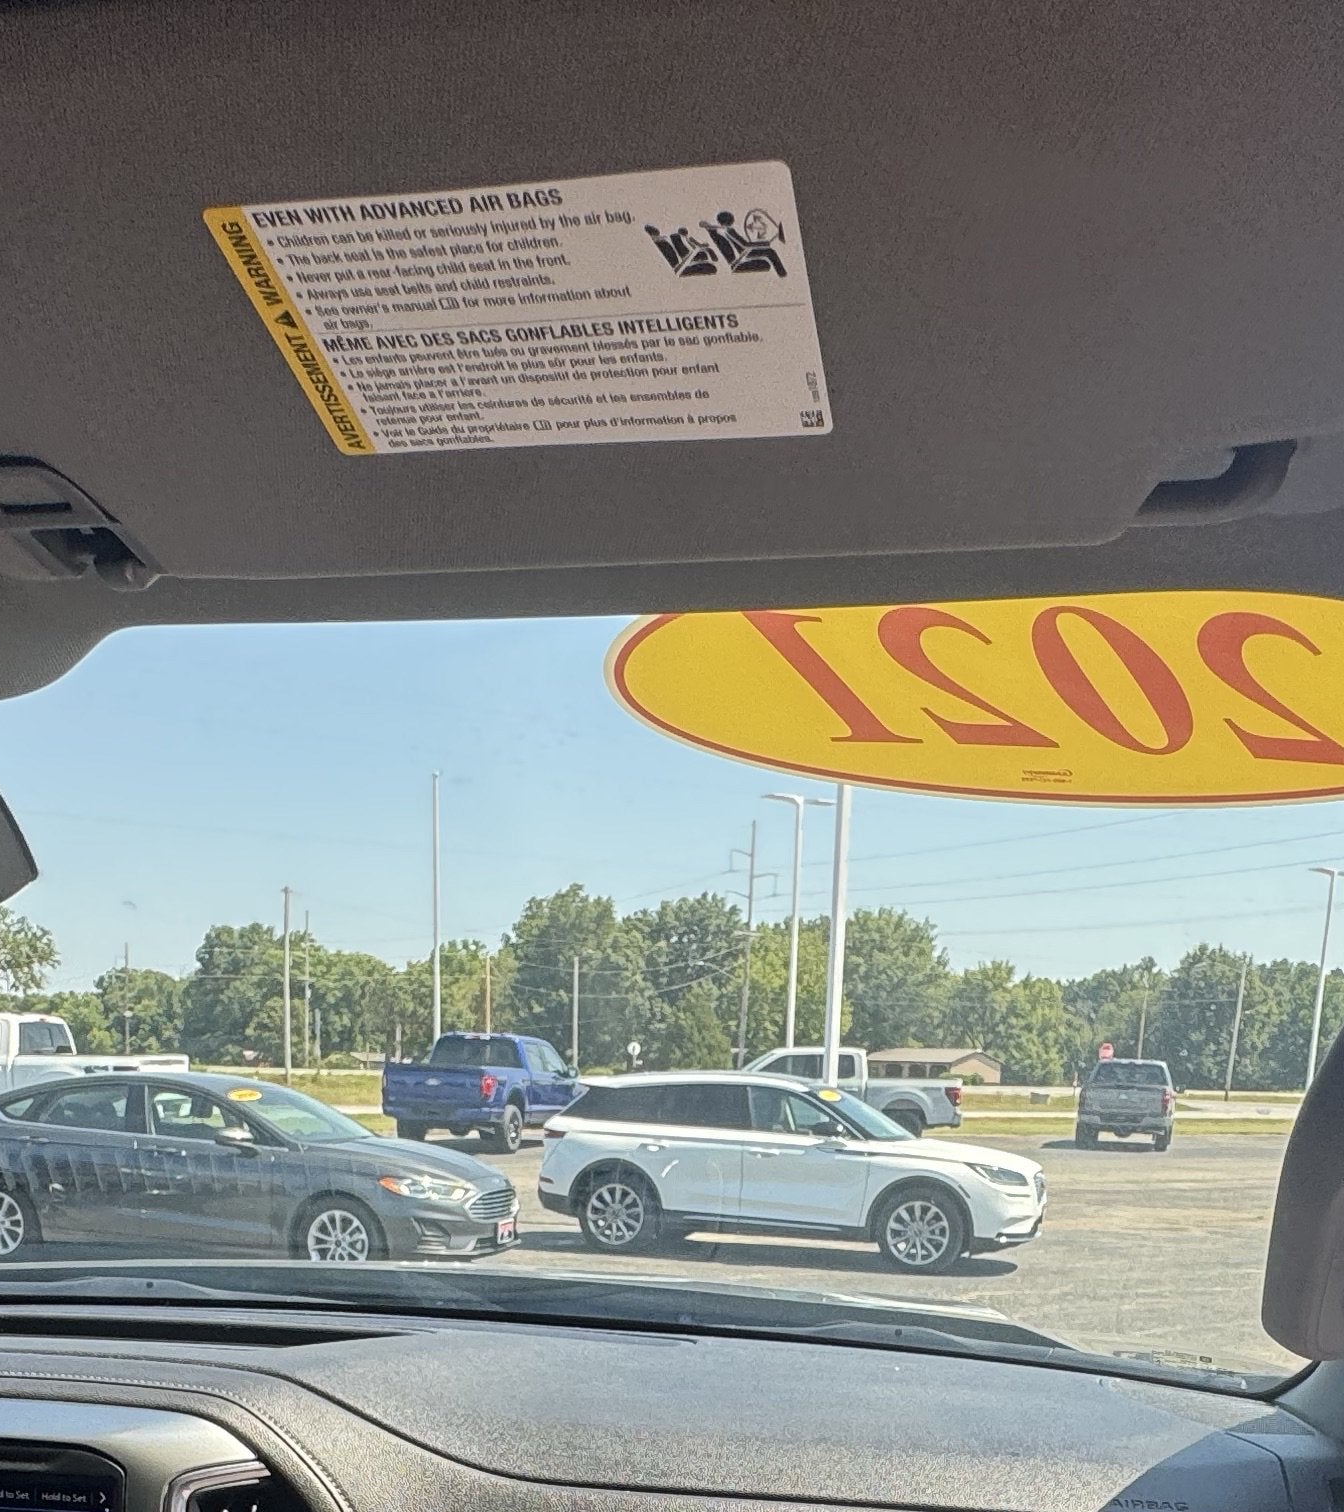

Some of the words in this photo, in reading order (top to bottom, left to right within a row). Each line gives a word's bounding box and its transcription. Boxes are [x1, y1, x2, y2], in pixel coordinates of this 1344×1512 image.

[252, 209, 303, 228] EVEN
[303, 205, 355, 224] WITH
[360, 197, 462, 220] ADVANCED
[469, 194, 503, 212] AIR
[506, 188, 562, 209] BAGS
[221, 220, 284, 306] WARNING
[321, 335, 373, 352] MÊME
[375, 334, 417, 349] AVEC
[420, 331, 454, 347] DES
[456, 328, 502, 345] SACS
[505, 321, 613, 341] GONFLABLES
[618, 313, 738, 334] INTELLIGENTS
[284, 332, 367, 451] AVERTISSEMENT
[15, 1489, 30, 1500] Set
[41, 1491, 61, 1502] Hold
[72, 1492, 87, 1503] Set
[1110, 1498, 1189, 1512] AIRBAG
